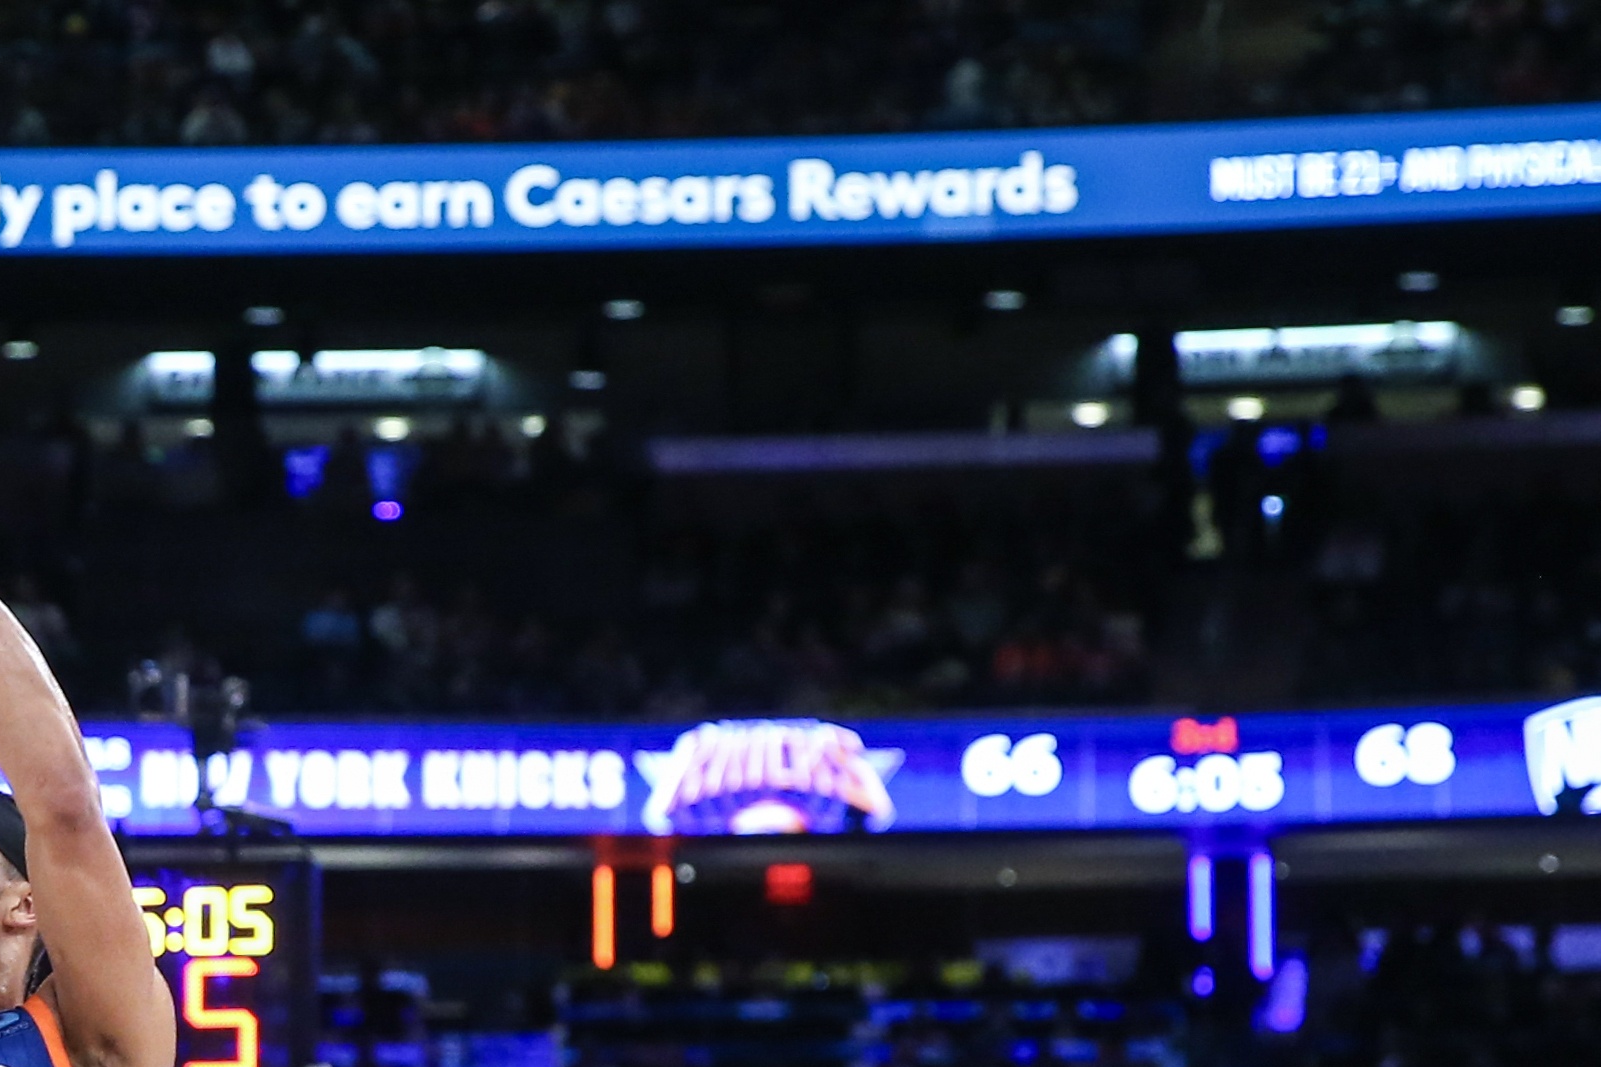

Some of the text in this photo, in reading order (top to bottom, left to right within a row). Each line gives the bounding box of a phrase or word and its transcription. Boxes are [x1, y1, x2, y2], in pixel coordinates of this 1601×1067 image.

[53, 169, 235, 246] place
[245, 174, 326, 230] to
[337, 181, 493, 229] earn
[505, 164, 775, 228] Caesars
[789, 150, 1078, 220] Rewards
[265, 749, 410, 809] YORK
[421, 750, 626, 809] KNICKS
[961, 733, 1063, 797] 66
[1128, 752, 1285, 814] 6:05
